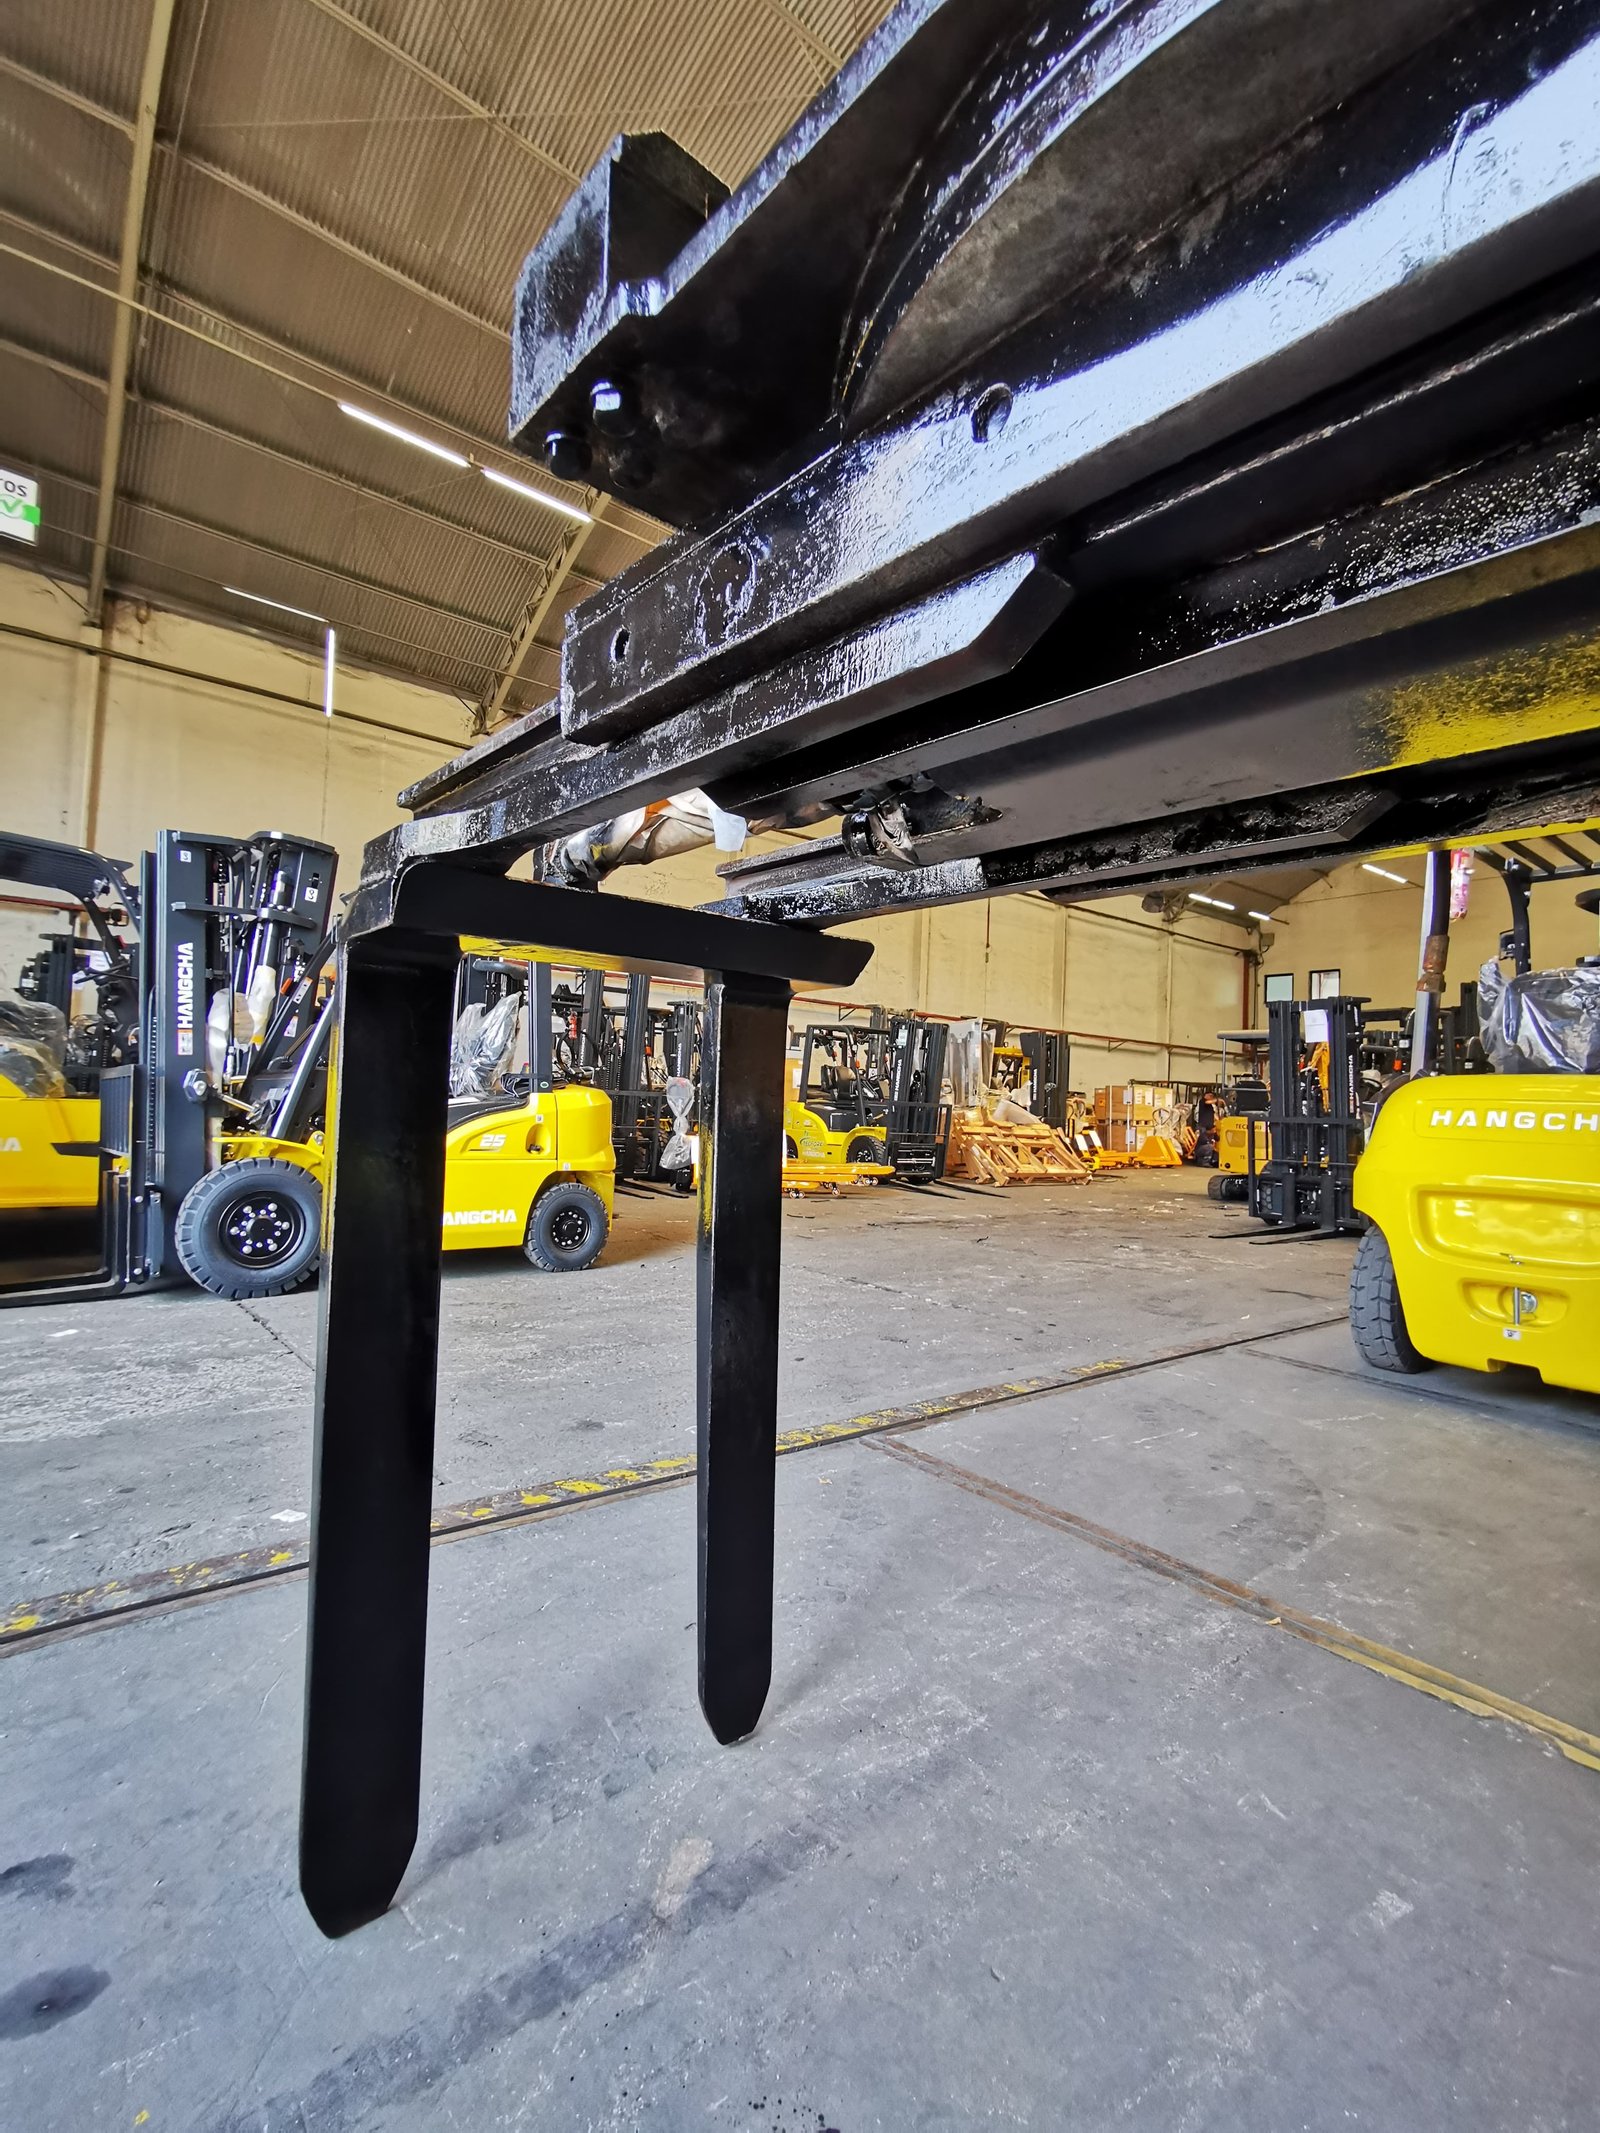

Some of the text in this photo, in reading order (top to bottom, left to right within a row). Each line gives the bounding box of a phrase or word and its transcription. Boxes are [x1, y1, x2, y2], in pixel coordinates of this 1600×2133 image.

[178, 942, 193, 1028] HANGCHA
[1430, 1110, 1599, 1132] HANGCH
[0, 1137, 22, 1152] A
[480, 1134, 506, 1147] 25
